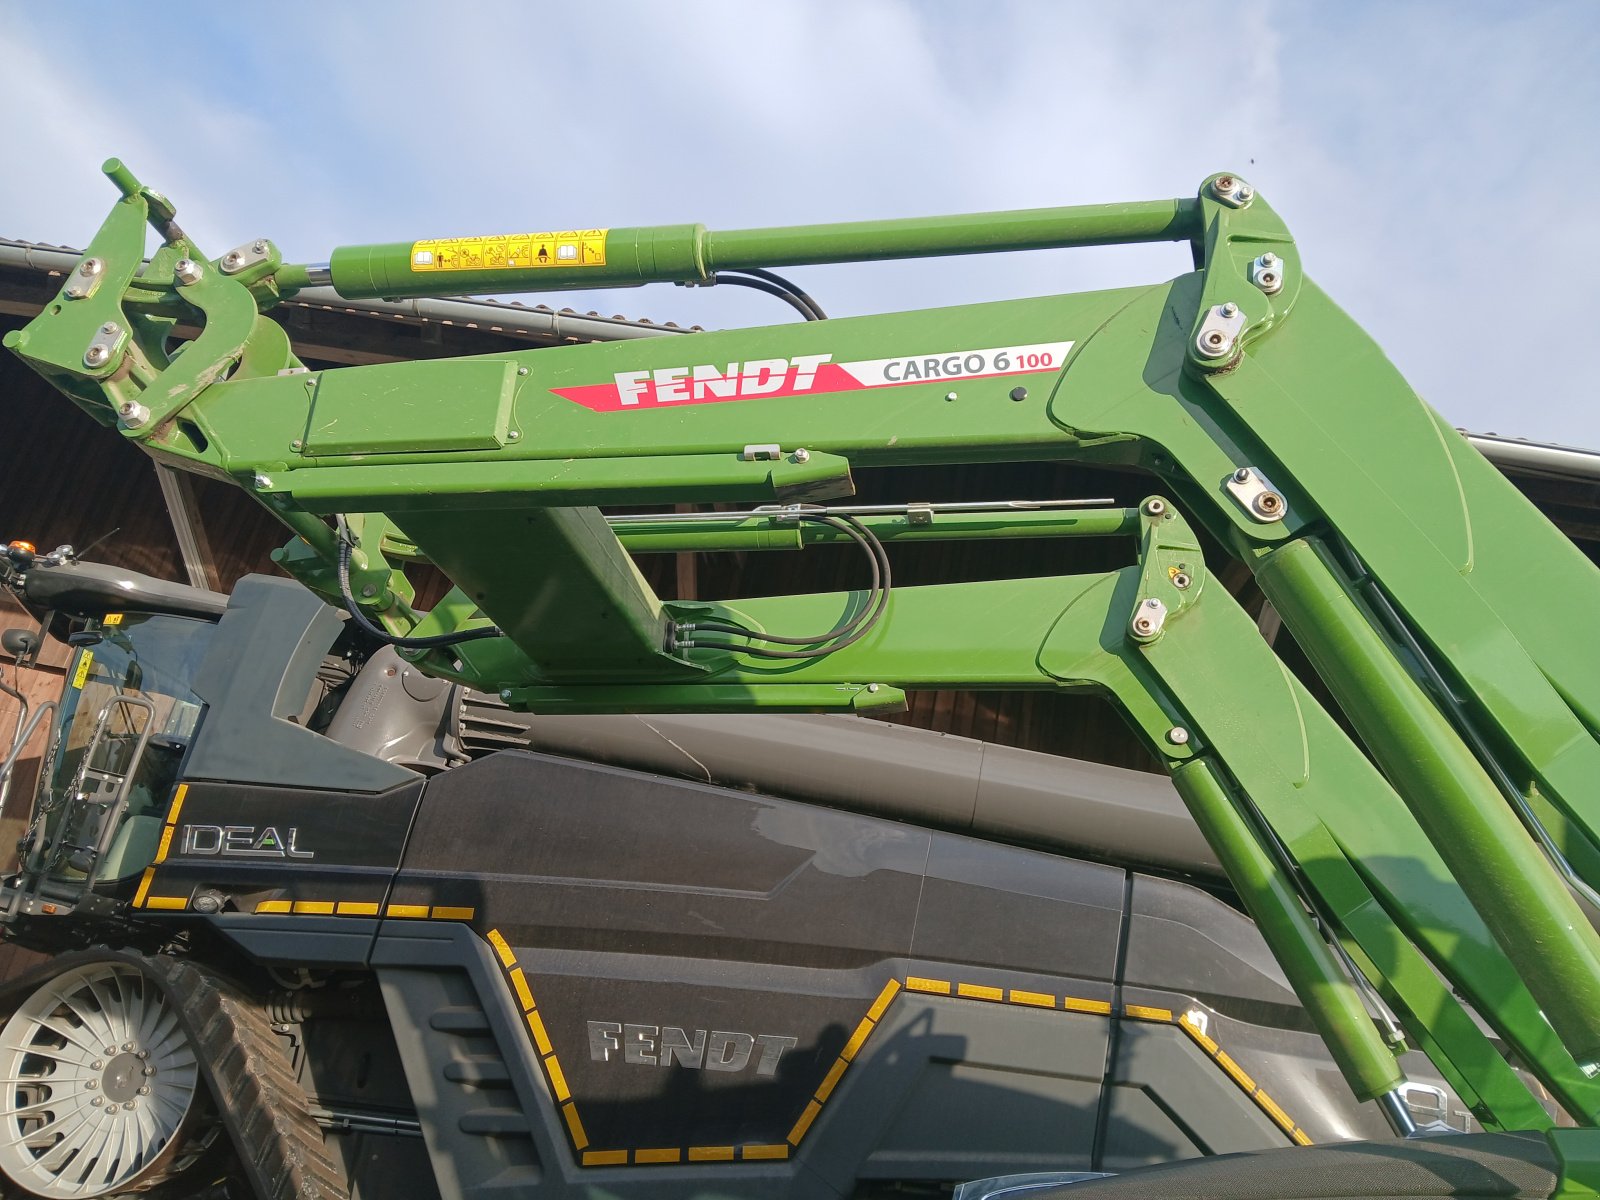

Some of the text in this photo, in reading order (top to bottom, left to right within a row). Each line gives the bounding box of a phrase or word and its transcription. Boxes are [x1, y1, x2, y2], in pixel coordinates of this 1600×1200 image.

[614, 352, 1053, 405] FENDT CARGO 6 100
[180, 824, 314, 858] IDEAL
[587, 1020, 798, 1075] FENDT
